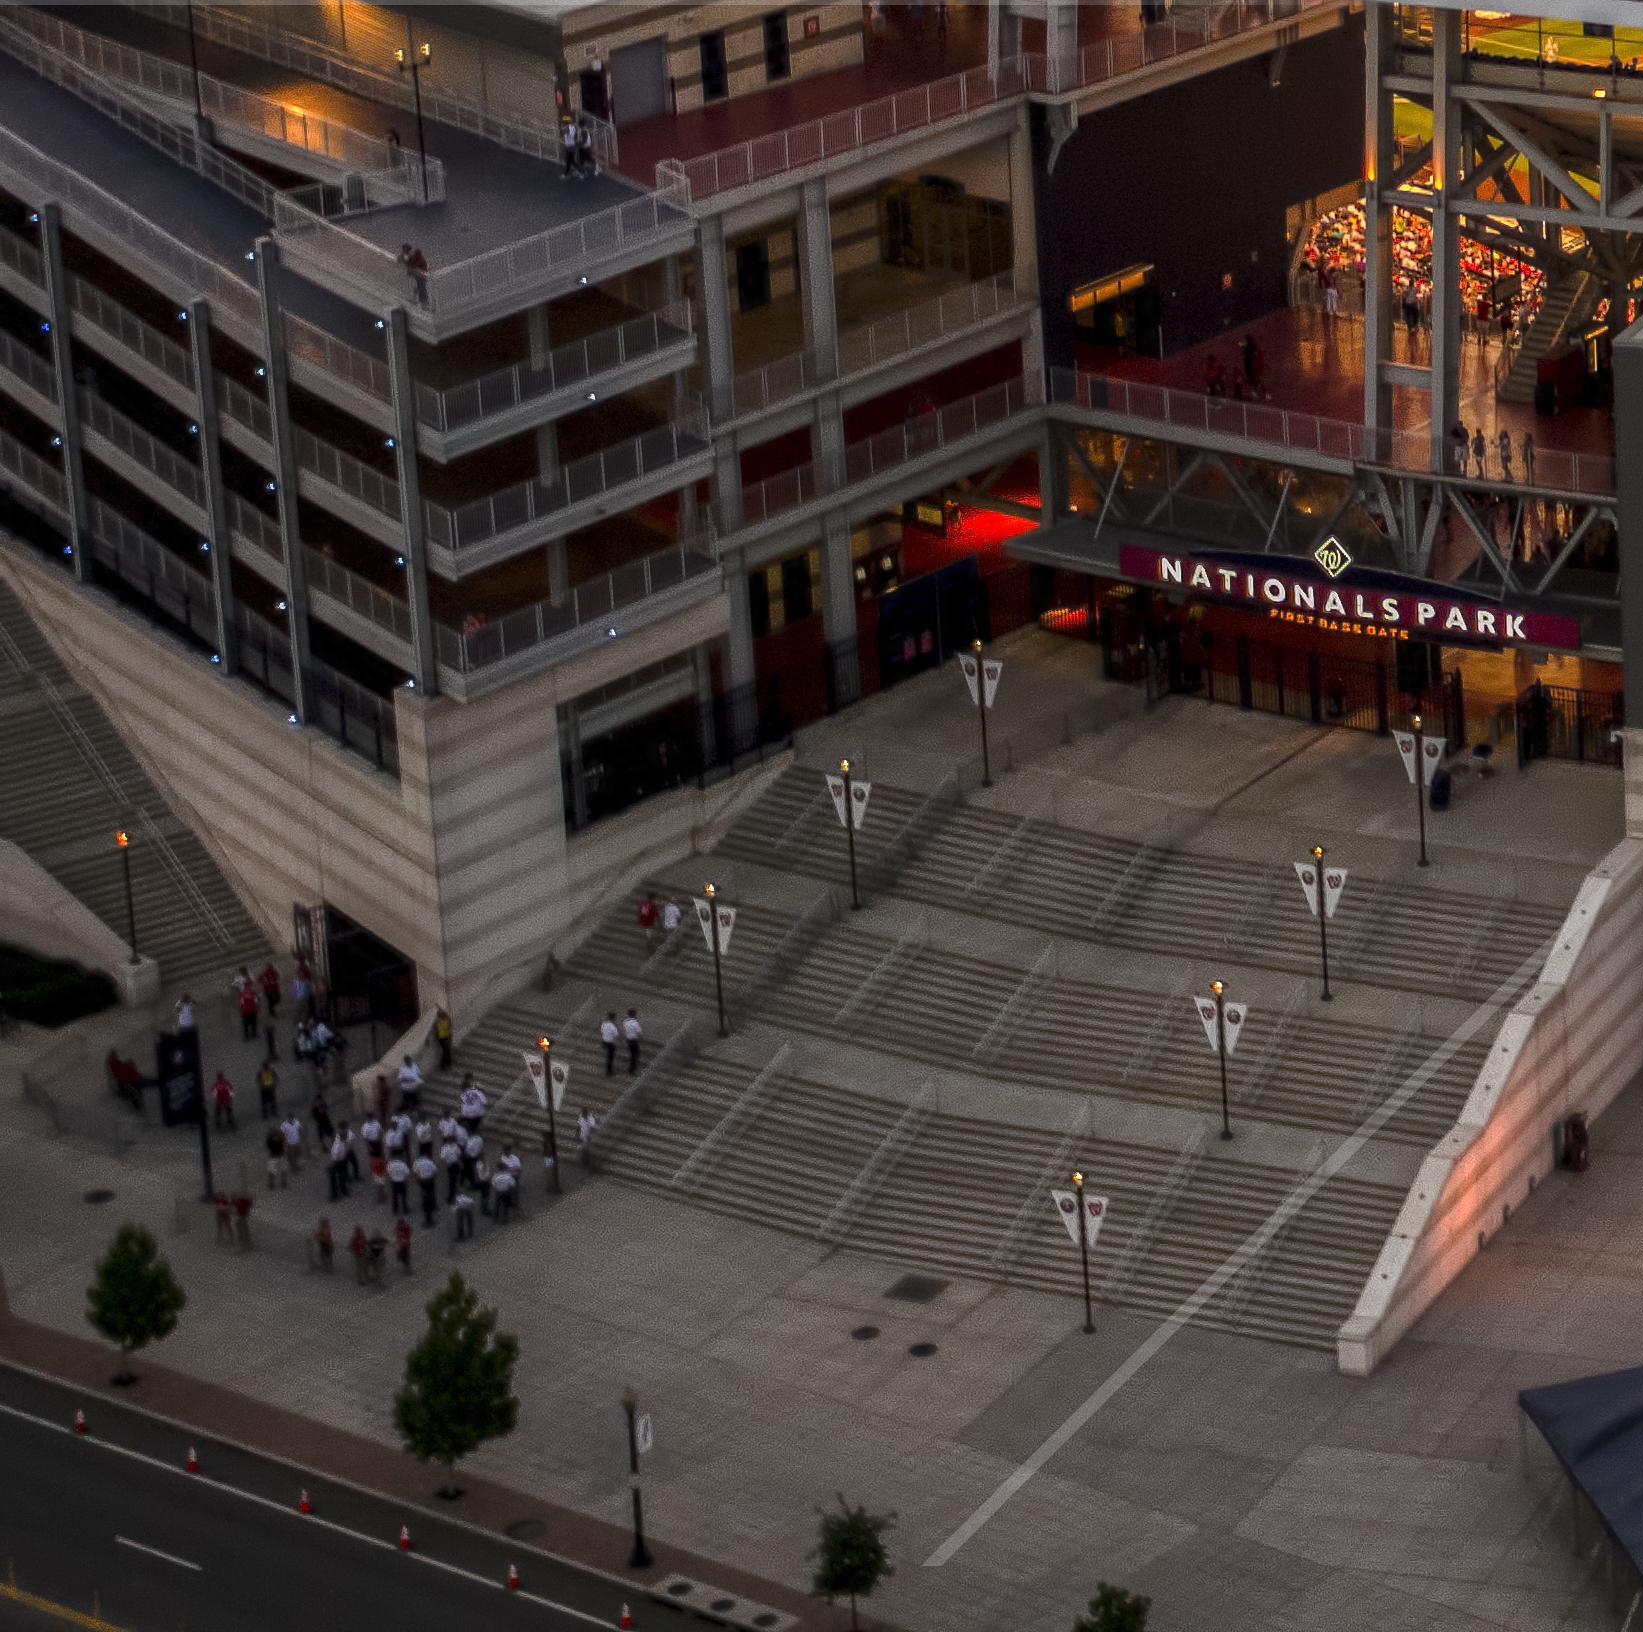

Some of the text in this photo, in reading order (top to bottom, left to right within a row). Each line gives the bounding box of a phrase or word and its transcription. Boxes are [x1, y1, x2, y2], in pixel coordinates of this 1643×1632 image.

[1160, 556, 1527, 640] NATIONALS PARK
[1270, 608, 1409, 640] FIRST BASE GATE
